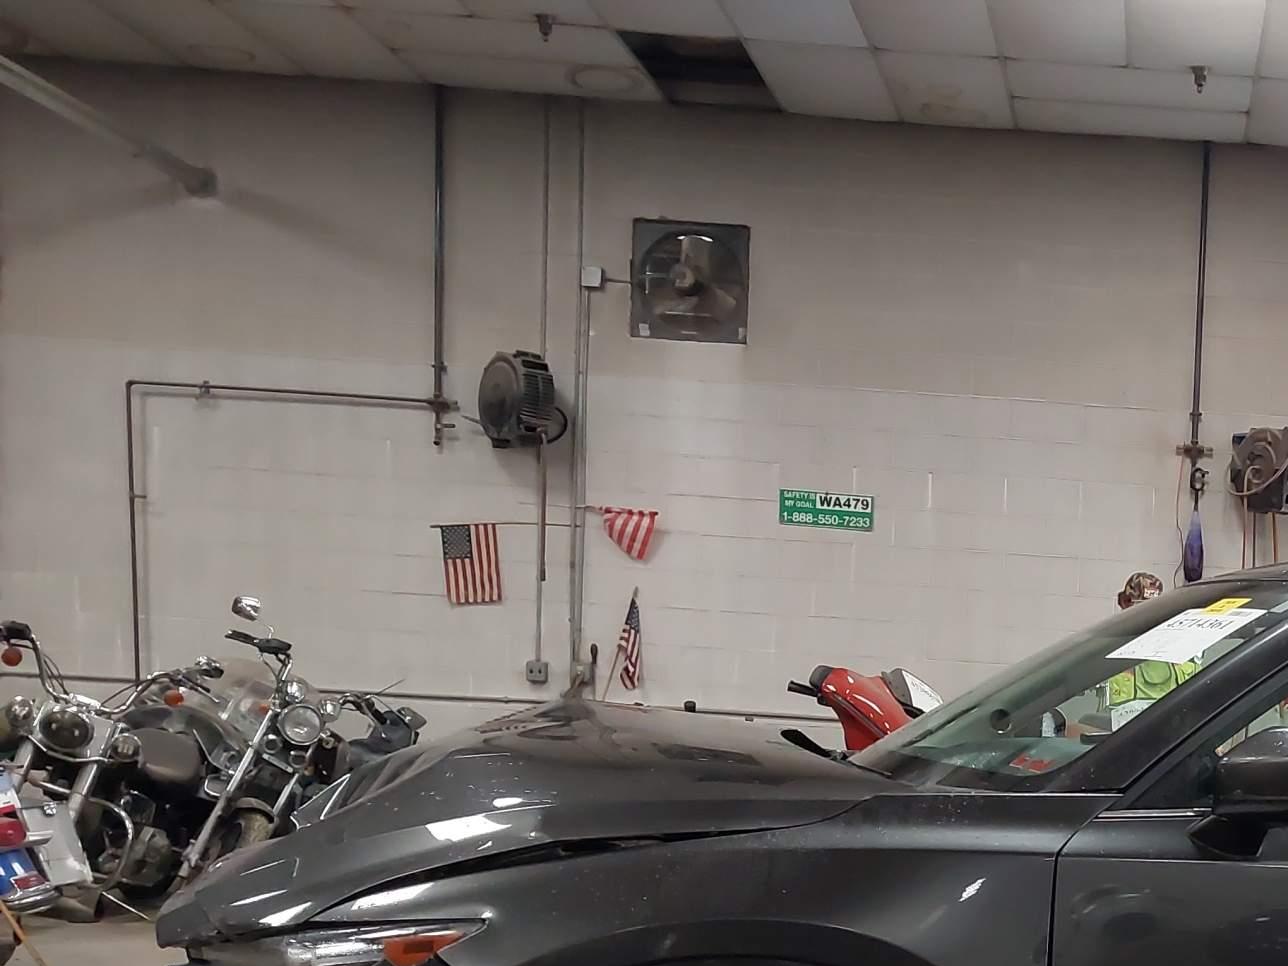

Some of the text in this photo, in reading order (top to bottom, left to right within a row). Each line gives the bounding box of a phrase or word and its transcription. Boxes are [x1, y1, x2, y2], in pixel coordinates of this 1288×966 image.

[783, 491, 808, 499] SAFETY
[819, 495, 870, 511] WA479
[782, 511, 870, 527] 1-888-550-7233
